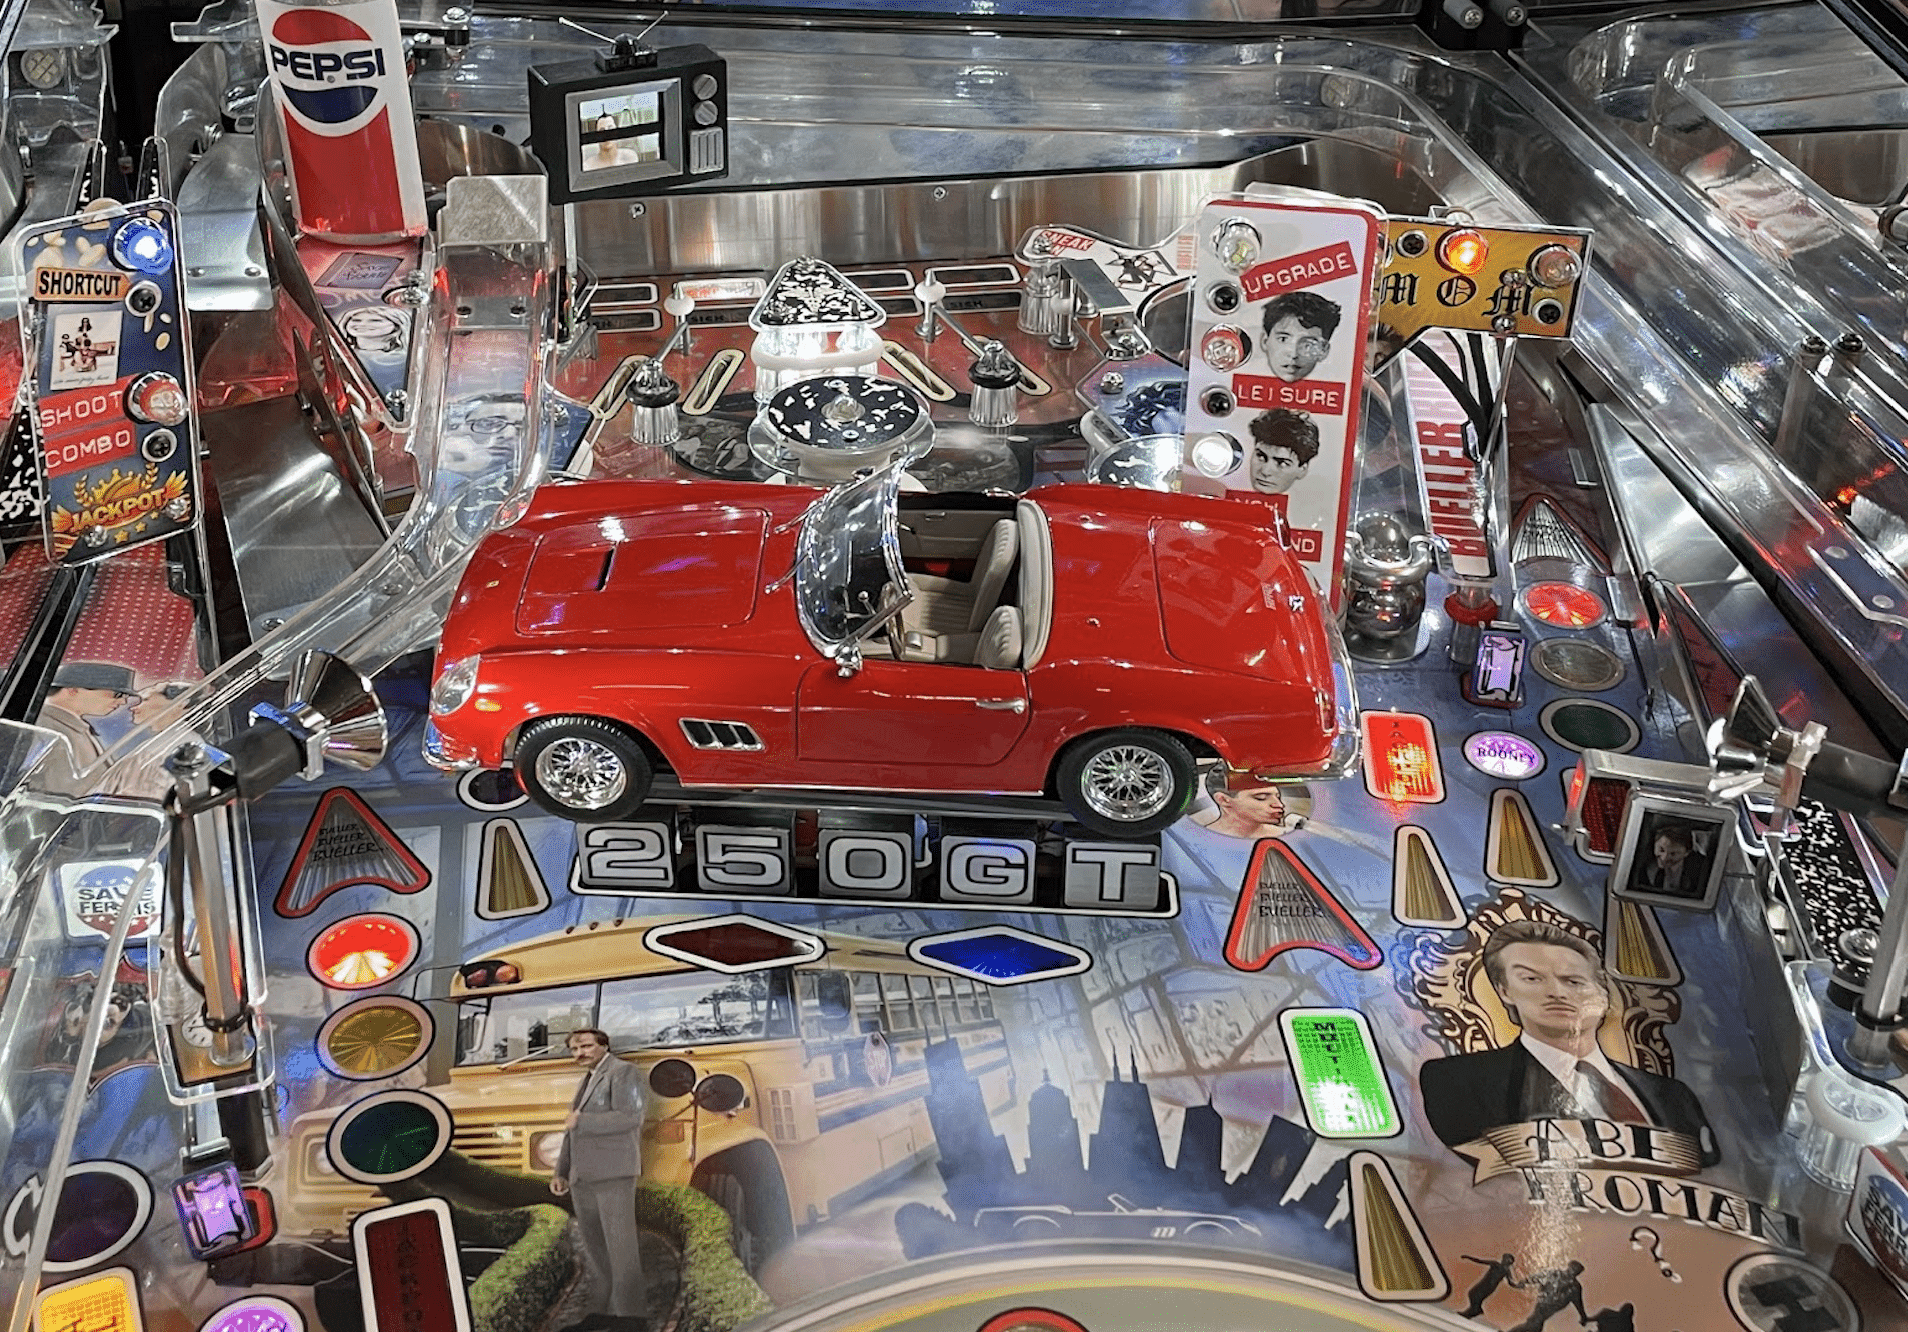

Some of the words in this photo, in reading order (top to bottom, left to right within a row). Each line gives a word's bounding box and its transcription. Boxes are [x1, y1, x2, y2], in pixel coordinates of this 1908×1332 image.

[270, 47, 386, 81] PEPSI
[1041, 230, 1096, 251] SNEAK
[38, 272, 122, 296] SHORTCUT
[1245, 251, 1351, 294] UPGRADE
[40, 390, 123, 428] SHOOT
[1237, 384, 1340, 408] LEISURE
[45, 429, 131, 469] COMBO
[1416, 421, 1488, 558] BUELLER
[71, 489, 168, 533] JACKPOT
[1478, 746, 1536, 764] ROONEY
[80, 901, 156, 915] FERIS
[1525, 1117, 1675, 1166] ABE
